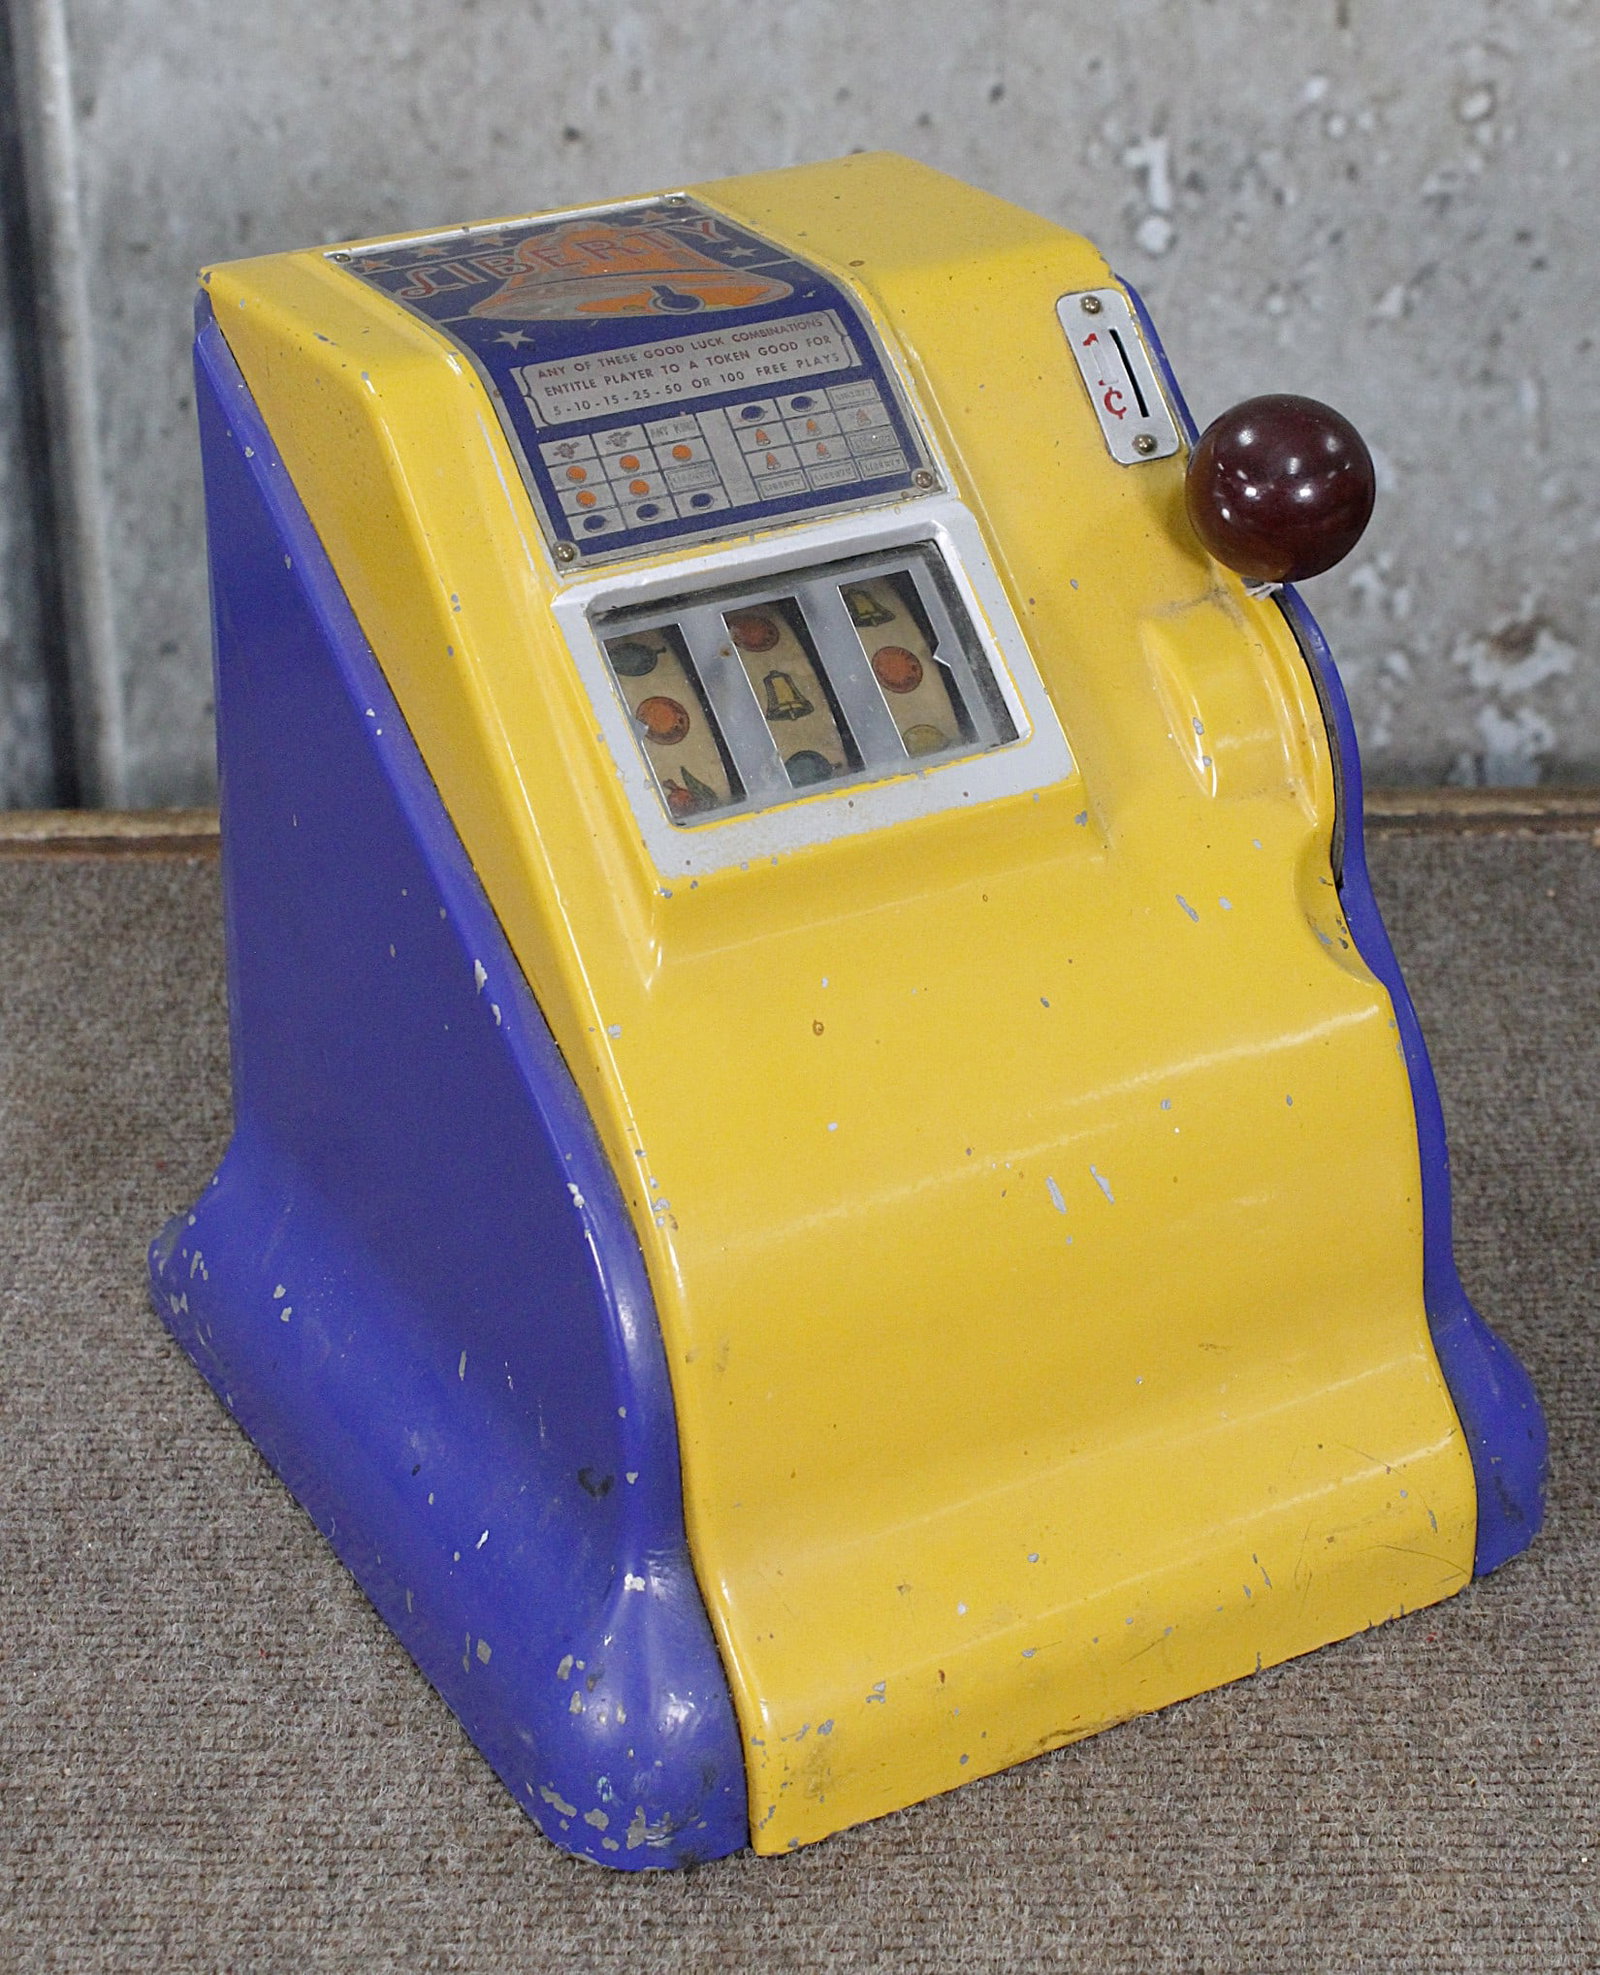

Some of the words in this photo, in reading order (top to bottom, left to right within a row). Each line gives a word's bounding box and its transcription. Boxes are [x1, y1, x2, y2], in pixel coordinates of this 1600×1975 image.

[399, 218, 731, 299] LIBERTY
[538, 366, 566, 379] ANY
[573, 361, 591, 372] OF
[597, 352, 638, 368] THESE
[643, 344, 685, 359] GOOD
[690, 337, 725, 350] LUCK
[731, 318, 823, 343] COMBINATIONS
[544, 379, 597, 397] ENTITLE
[603, 368, 654, 385] PLAYER
[660, 363, 680, 375] TO
[689, 360, 699, 369] A
[706, 350, 750, 367] TOKEN
[757, 341, 799, 356] GOOD
[806, 335, 832, 348] FOR
[691, 376, 711, 389] OR
[720, 371, 745, 383] 100
[755, 362, 788, 376] FREE
[796, 352, 840, 369] PLAYS
